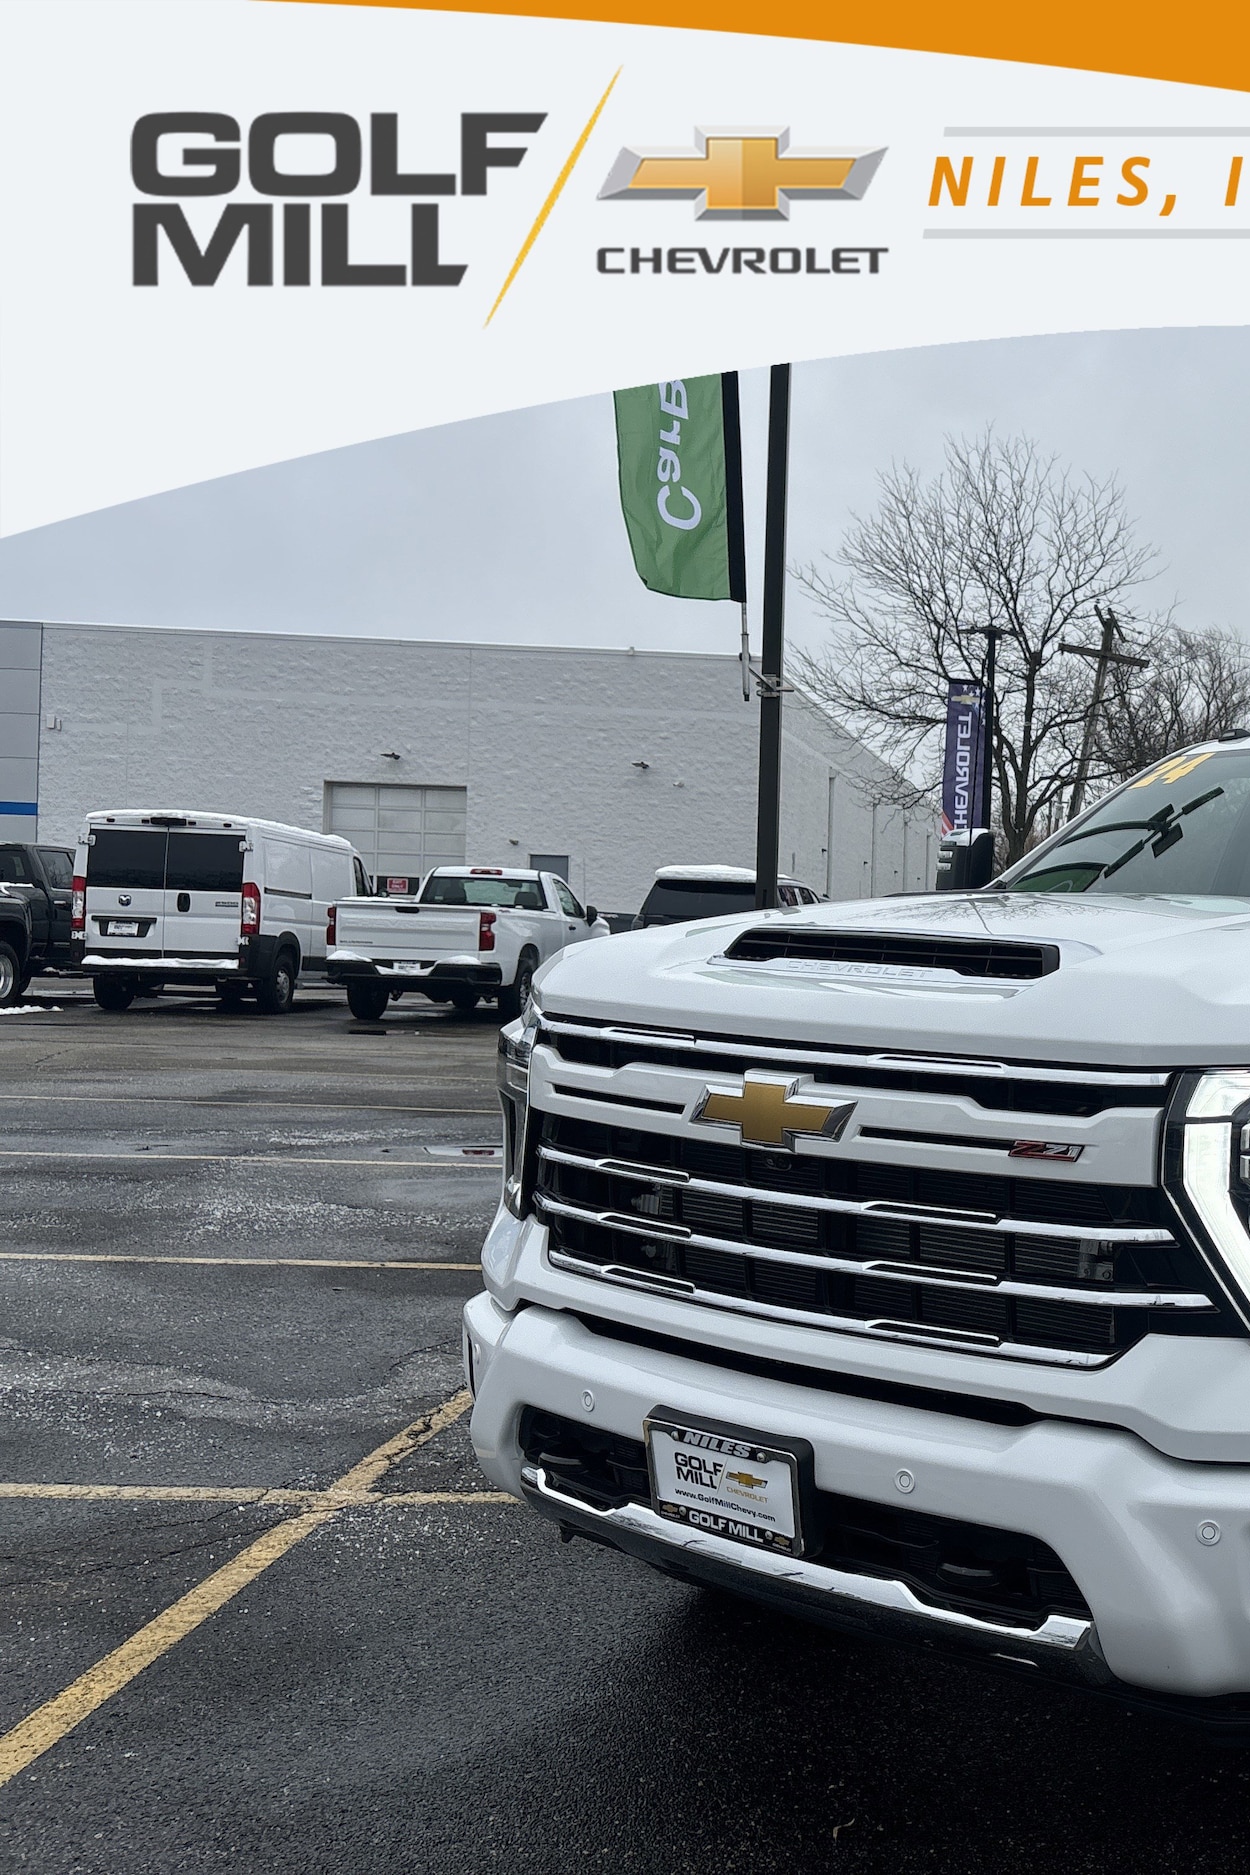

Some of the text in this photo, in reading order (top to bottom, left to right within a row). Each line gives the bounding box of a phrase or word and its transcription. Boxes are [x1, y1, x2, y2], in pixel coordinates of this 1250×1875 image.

[788, 960, 934, 979] CHEVROLET
[1008, 1140, 1085, 1162] Z71
[683, 1431, 751, 1458] NILES
[674, 1452, 723, 1476] GOLF
[676, 1466, 717, 1489] MILL
[675, 1488, 776, 1522] www.GolfMillChevy.com
[726, 1486, 768, 1504] CHEVROLET
[688, 1510, 763, 1543] GOLF MILL
